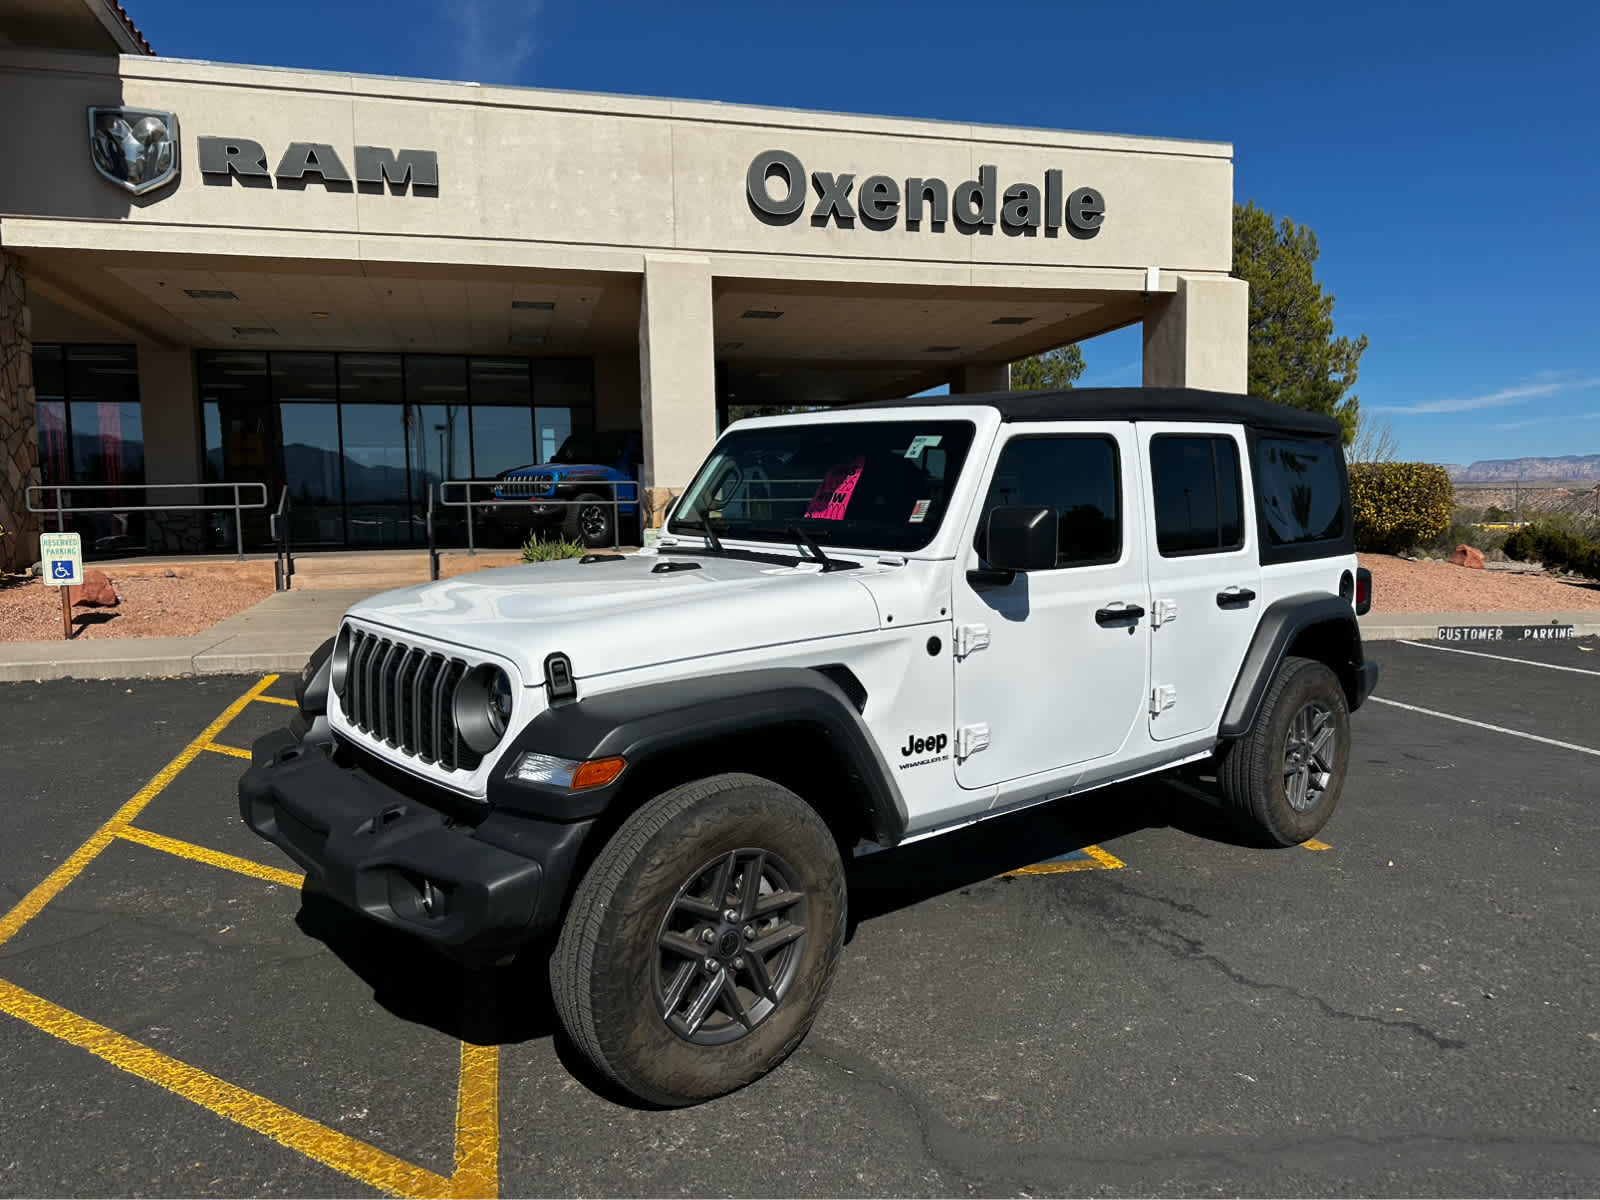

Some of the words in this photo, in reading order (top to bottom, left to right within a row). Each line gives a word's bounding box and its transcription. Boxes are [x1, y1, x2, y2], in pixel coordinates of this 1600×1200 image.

[197, 135, 439, 198] RAM
[746, 149, 1105, 240] Oxendale
[43, 539, 78, 547] RESERVED
[46, 548, 77, 556] PARKING
[1438, 628, 1503, 641] CUSTOMER
[1524, 627, 1574, 640] PARKING
[901, 733, 948, 757] Jeep
